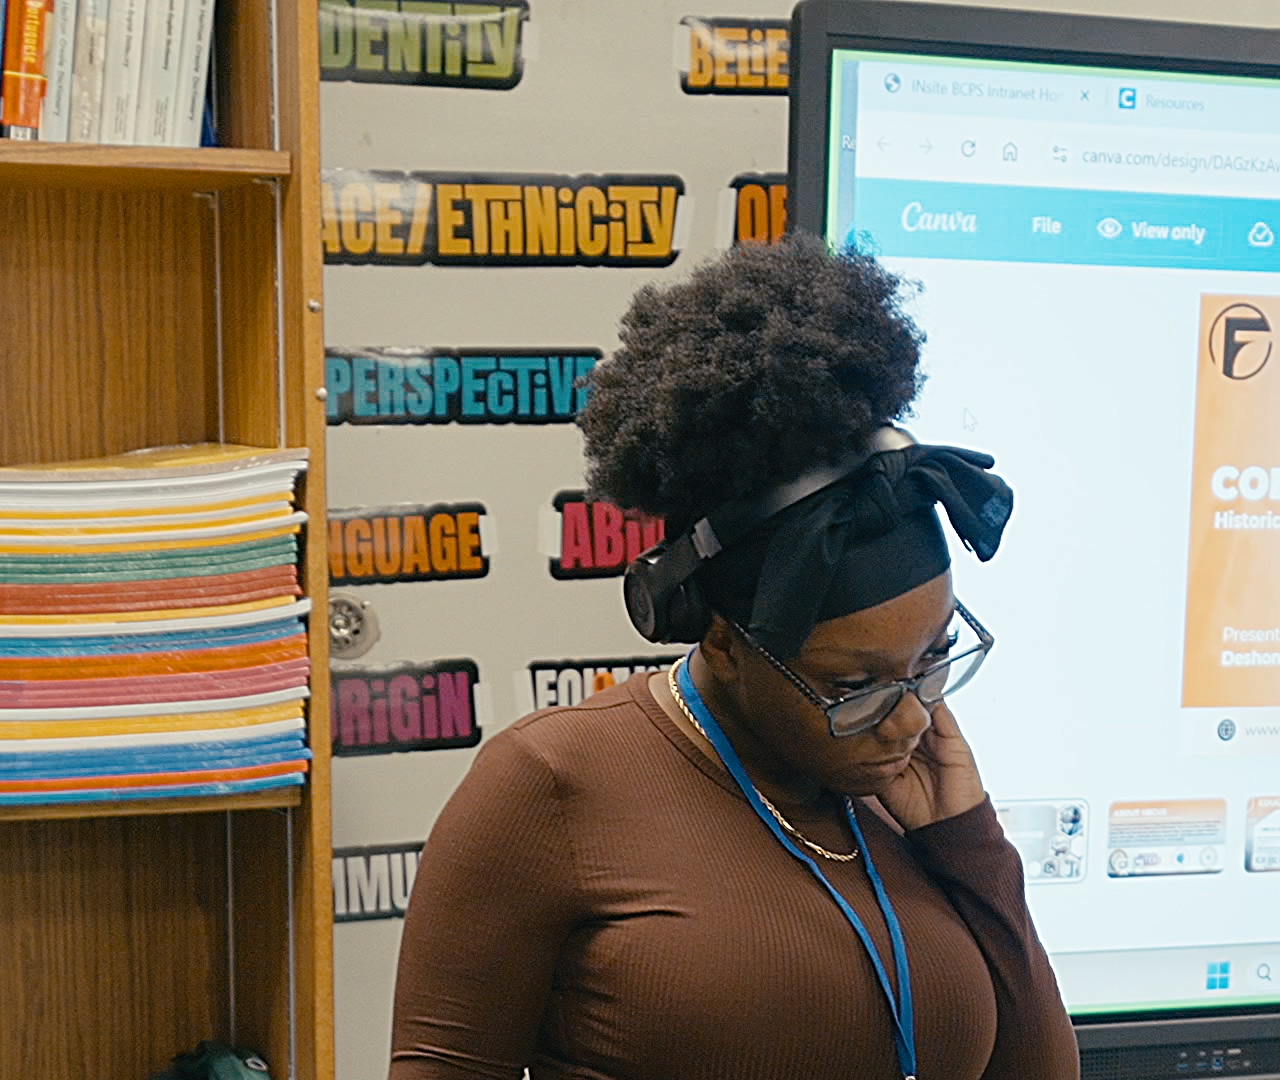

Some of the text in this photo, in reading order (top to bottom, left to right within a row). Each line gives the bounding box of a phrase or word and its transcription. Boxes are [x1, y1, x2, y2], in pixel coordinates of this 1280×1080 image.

[987, 83, 1036, 102] Intranet
[1146, 94, 1205, 112] Resources
[901, 202, 1206, 245] Canva File View only
